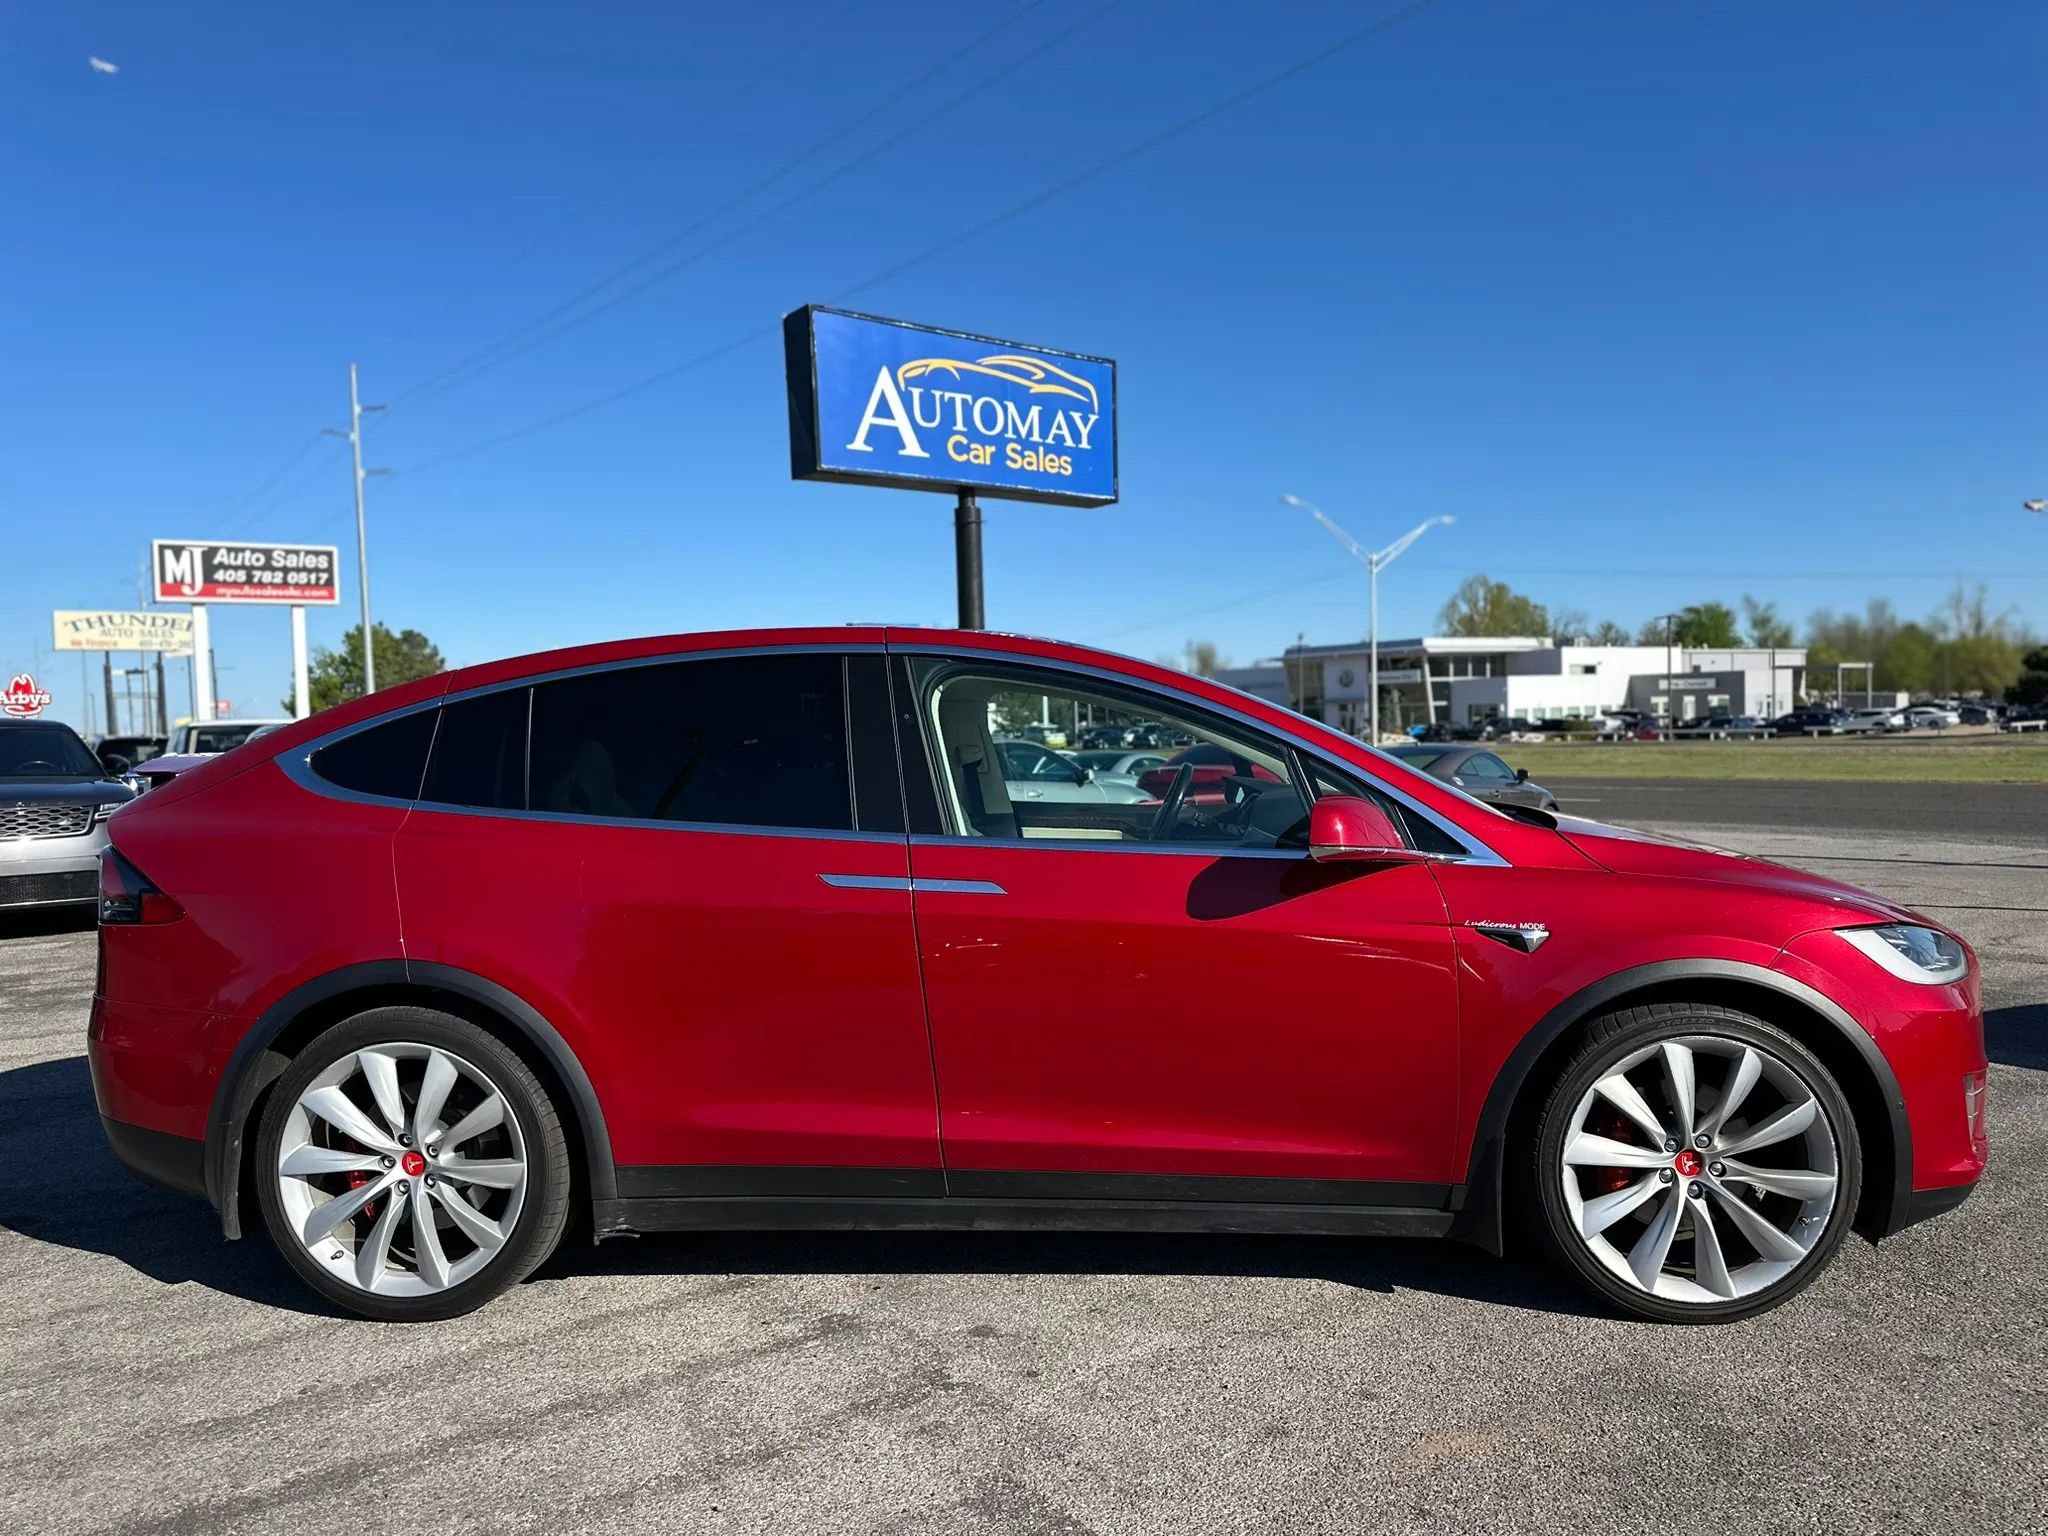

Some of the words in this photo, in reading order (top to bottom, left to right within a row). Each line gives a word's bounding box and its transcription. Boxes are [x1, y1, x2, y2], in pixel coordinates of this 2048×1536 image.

[846, 365, 1099, 458] AUTOMAY
[947, 434, 996, 465] Car
[1005, 442, 1073, 476] Sales
[213, 548, 265, 566] Auto
[271, 550, 329, 569] Sales
[163, 546, 208, 596] MJ
[213, 569, 246, 583] 405
[251, 570, 283, 584] 782
[286, 571, 329, 585] 0517
[69, 614, 192, 632] THUNDE
[100, 628, 133, 638] AUTO
[140, 628, 174, 638] SALES
[1464, 919, 1517, 929] Ludicrous
[1519, 922, 1546, 931] MODE
